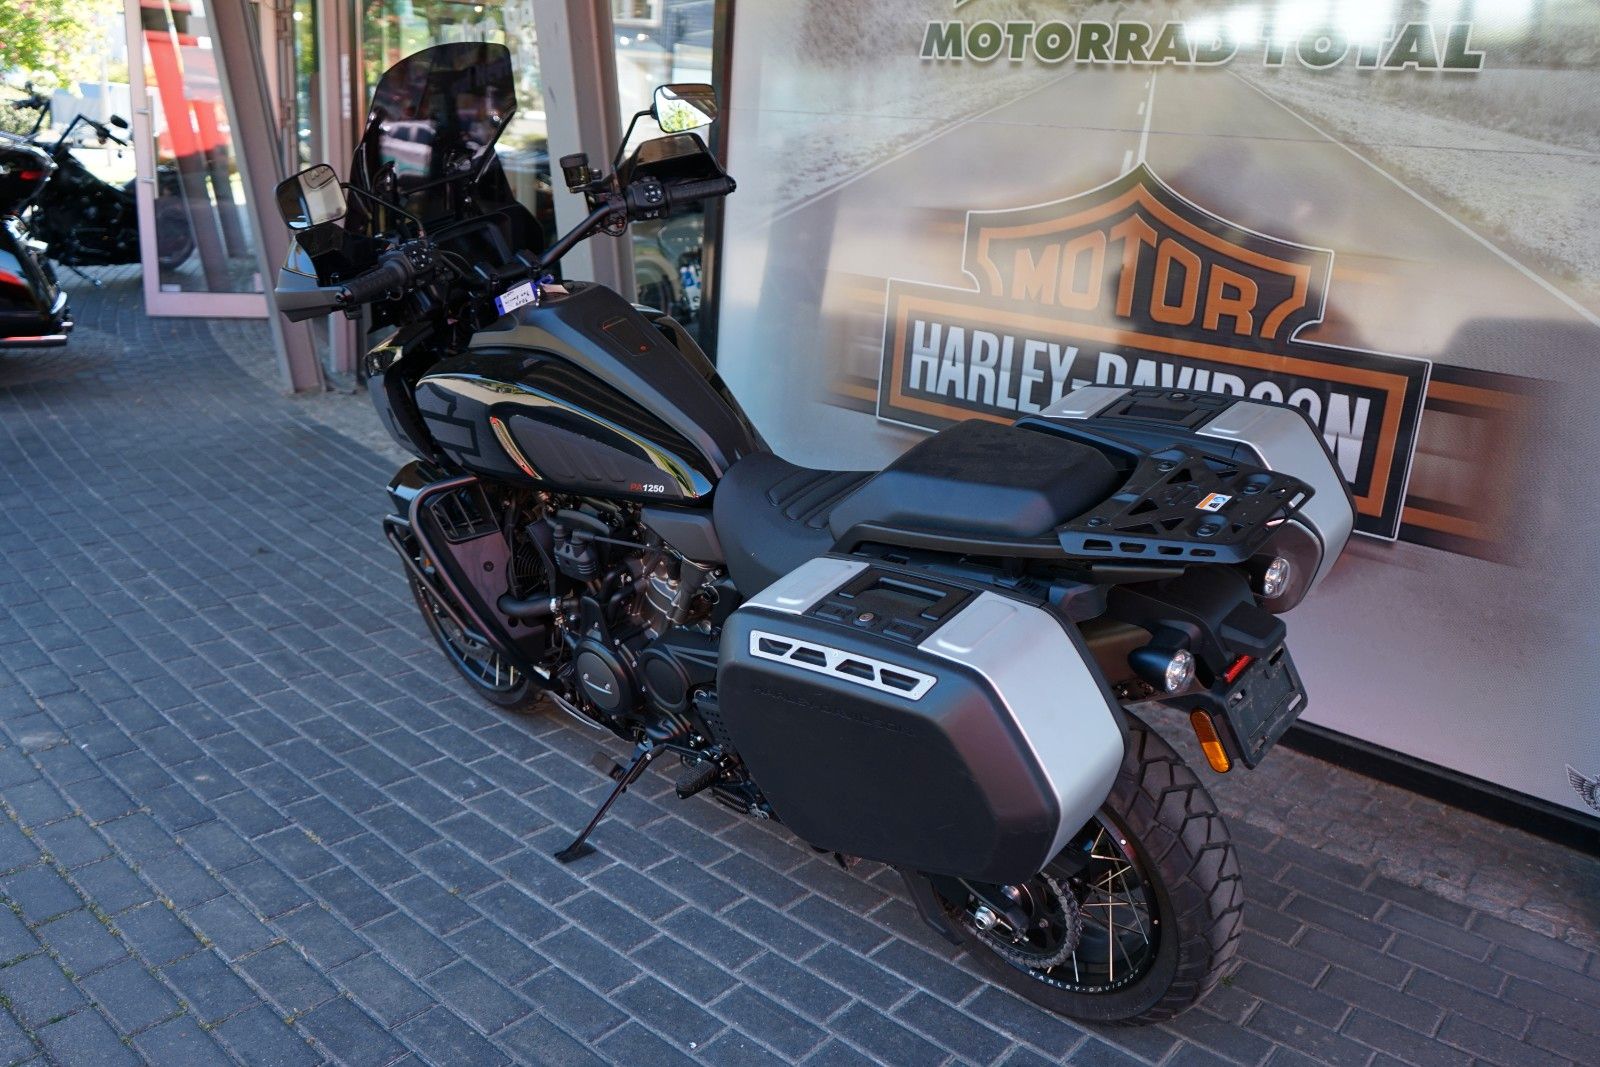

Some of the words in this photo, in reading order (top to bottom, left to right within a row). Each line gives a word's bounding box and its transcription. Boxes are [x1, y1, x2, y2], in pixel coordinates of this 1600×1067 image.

[921, 20, 1239, 66] MOTORRAD
[1262, 22, 1486, 72] TOTAL
[1011, 213, 1258, 337] MOTOR
[1028, 968, 1139, 993] HARLEY-DAVIDSON
